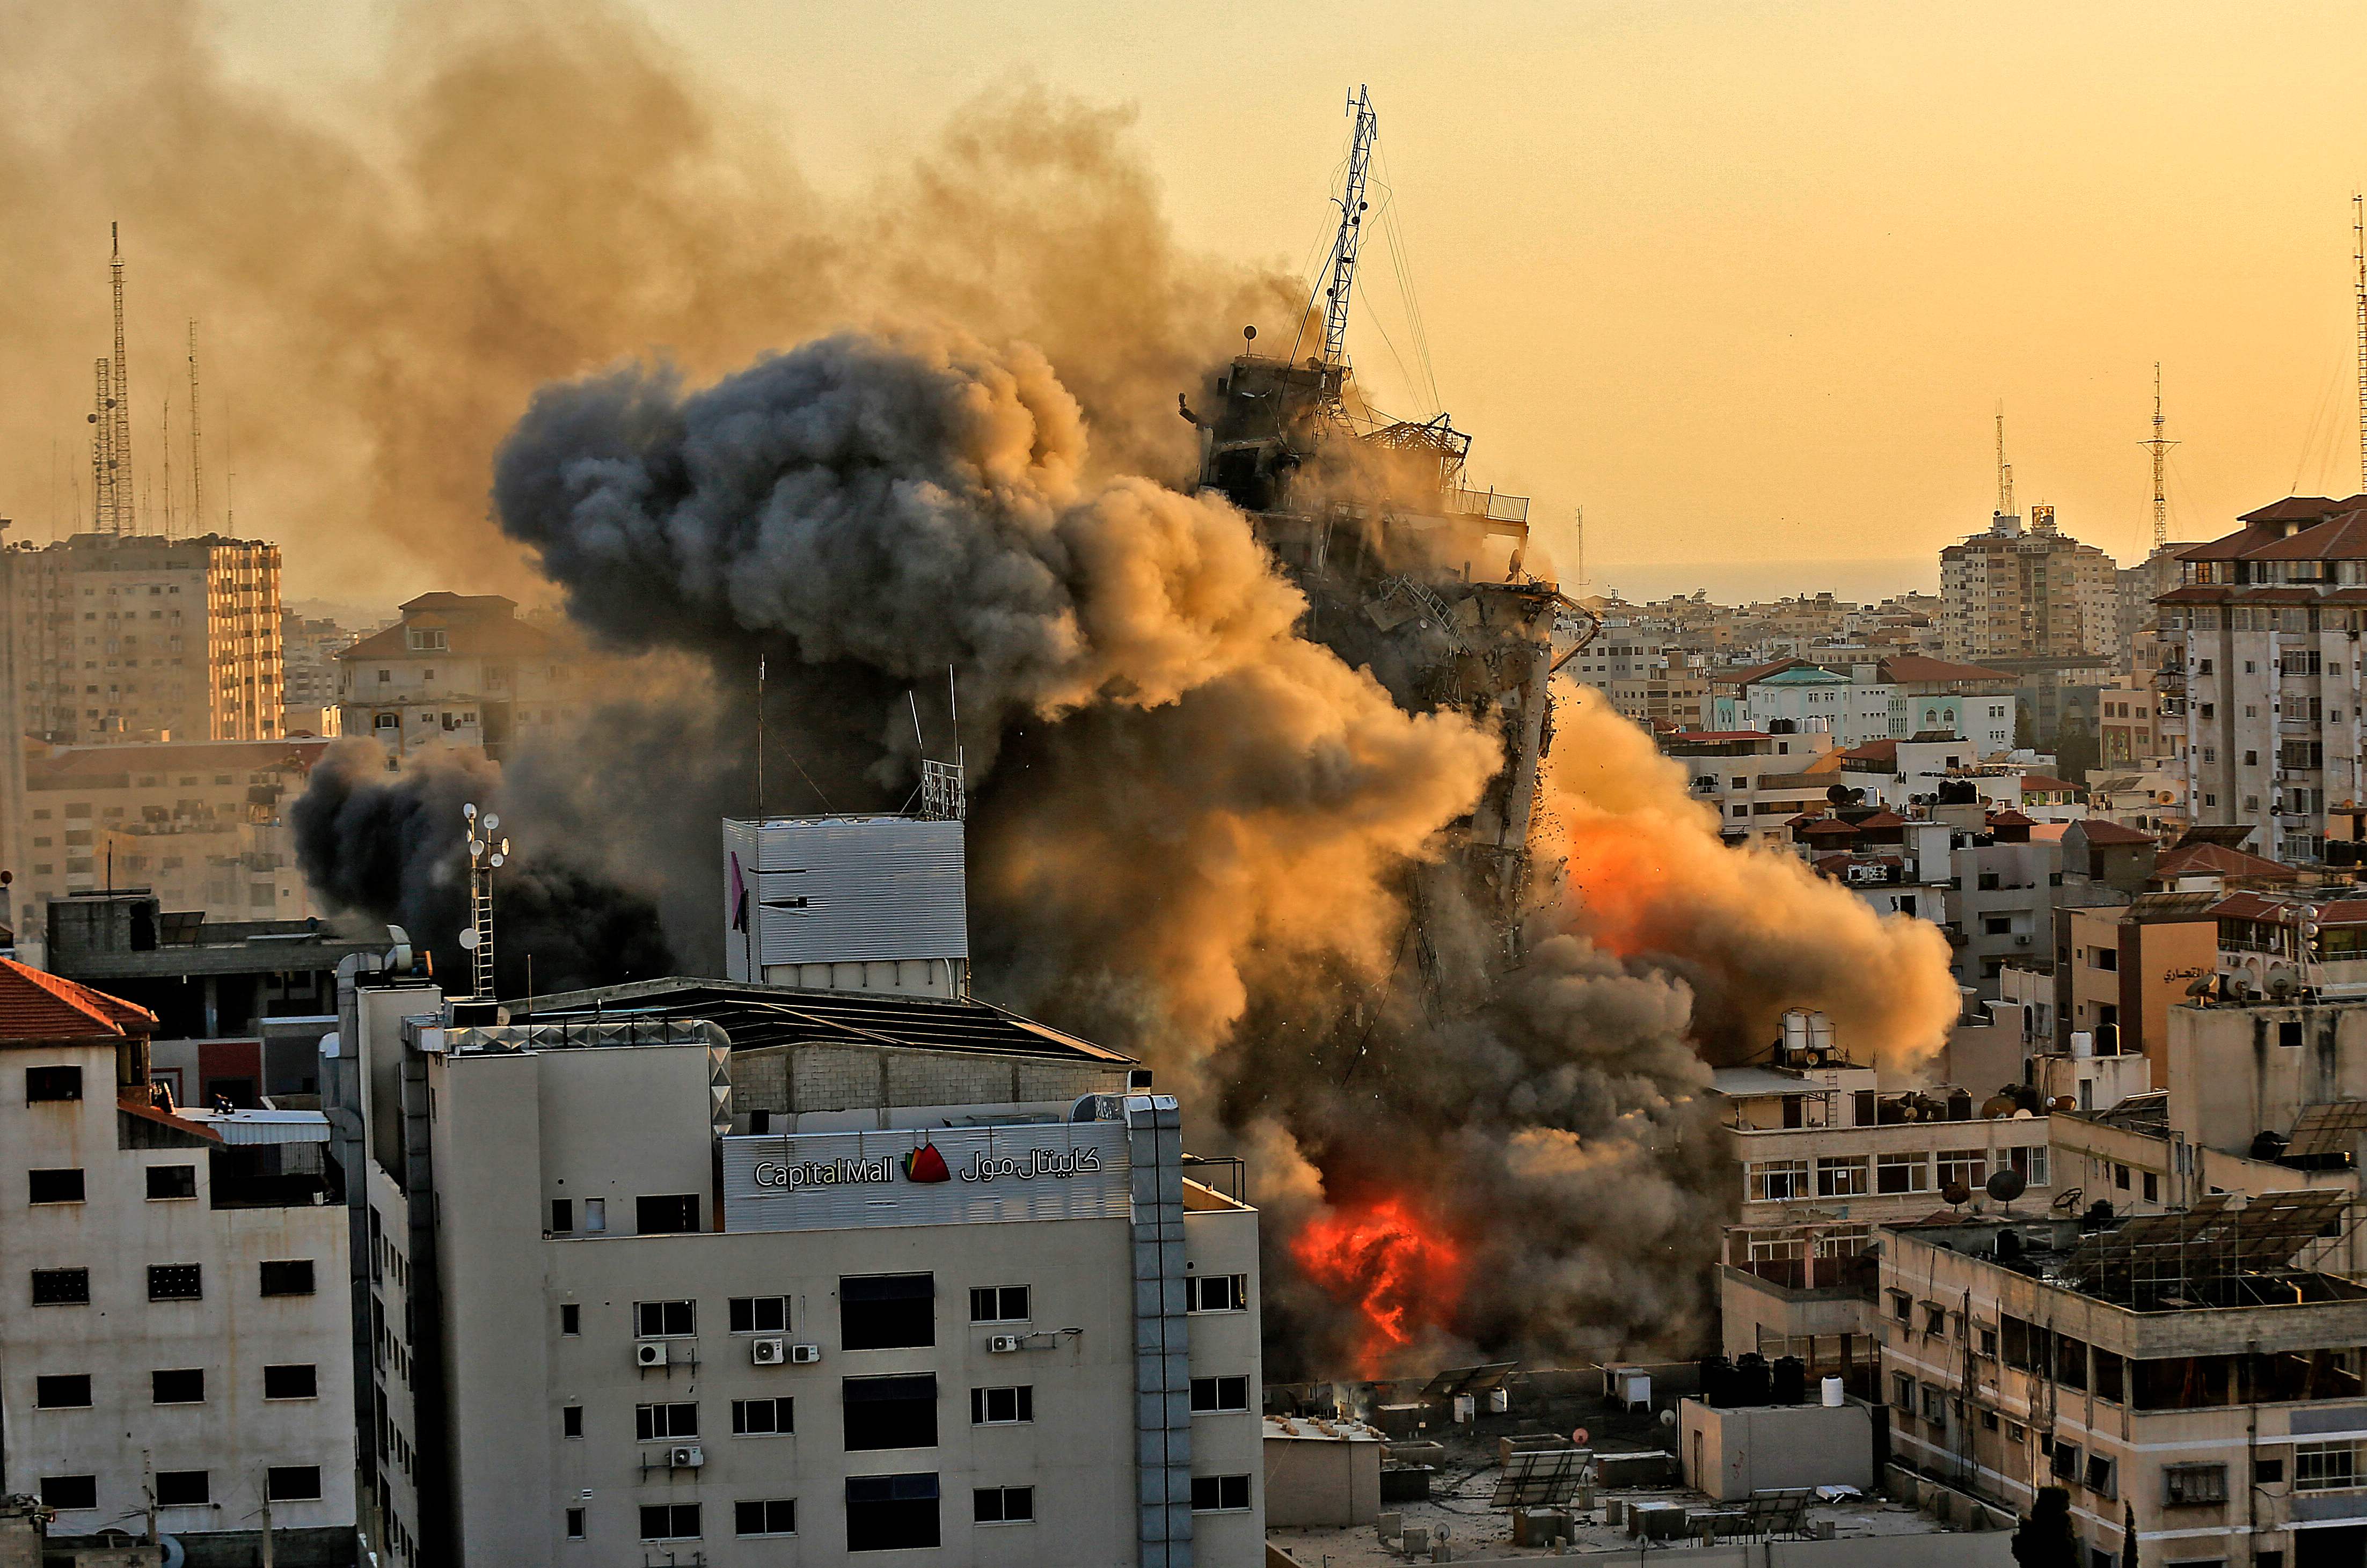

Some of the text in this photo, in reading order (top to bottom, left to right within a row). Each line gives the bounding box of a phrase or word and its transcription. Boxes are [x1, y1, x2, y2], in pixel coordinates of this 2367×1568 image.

[755, 1156, 893, 1191] Capital Mall
[960, 1147, 1101, 1182] كابيتال مول
